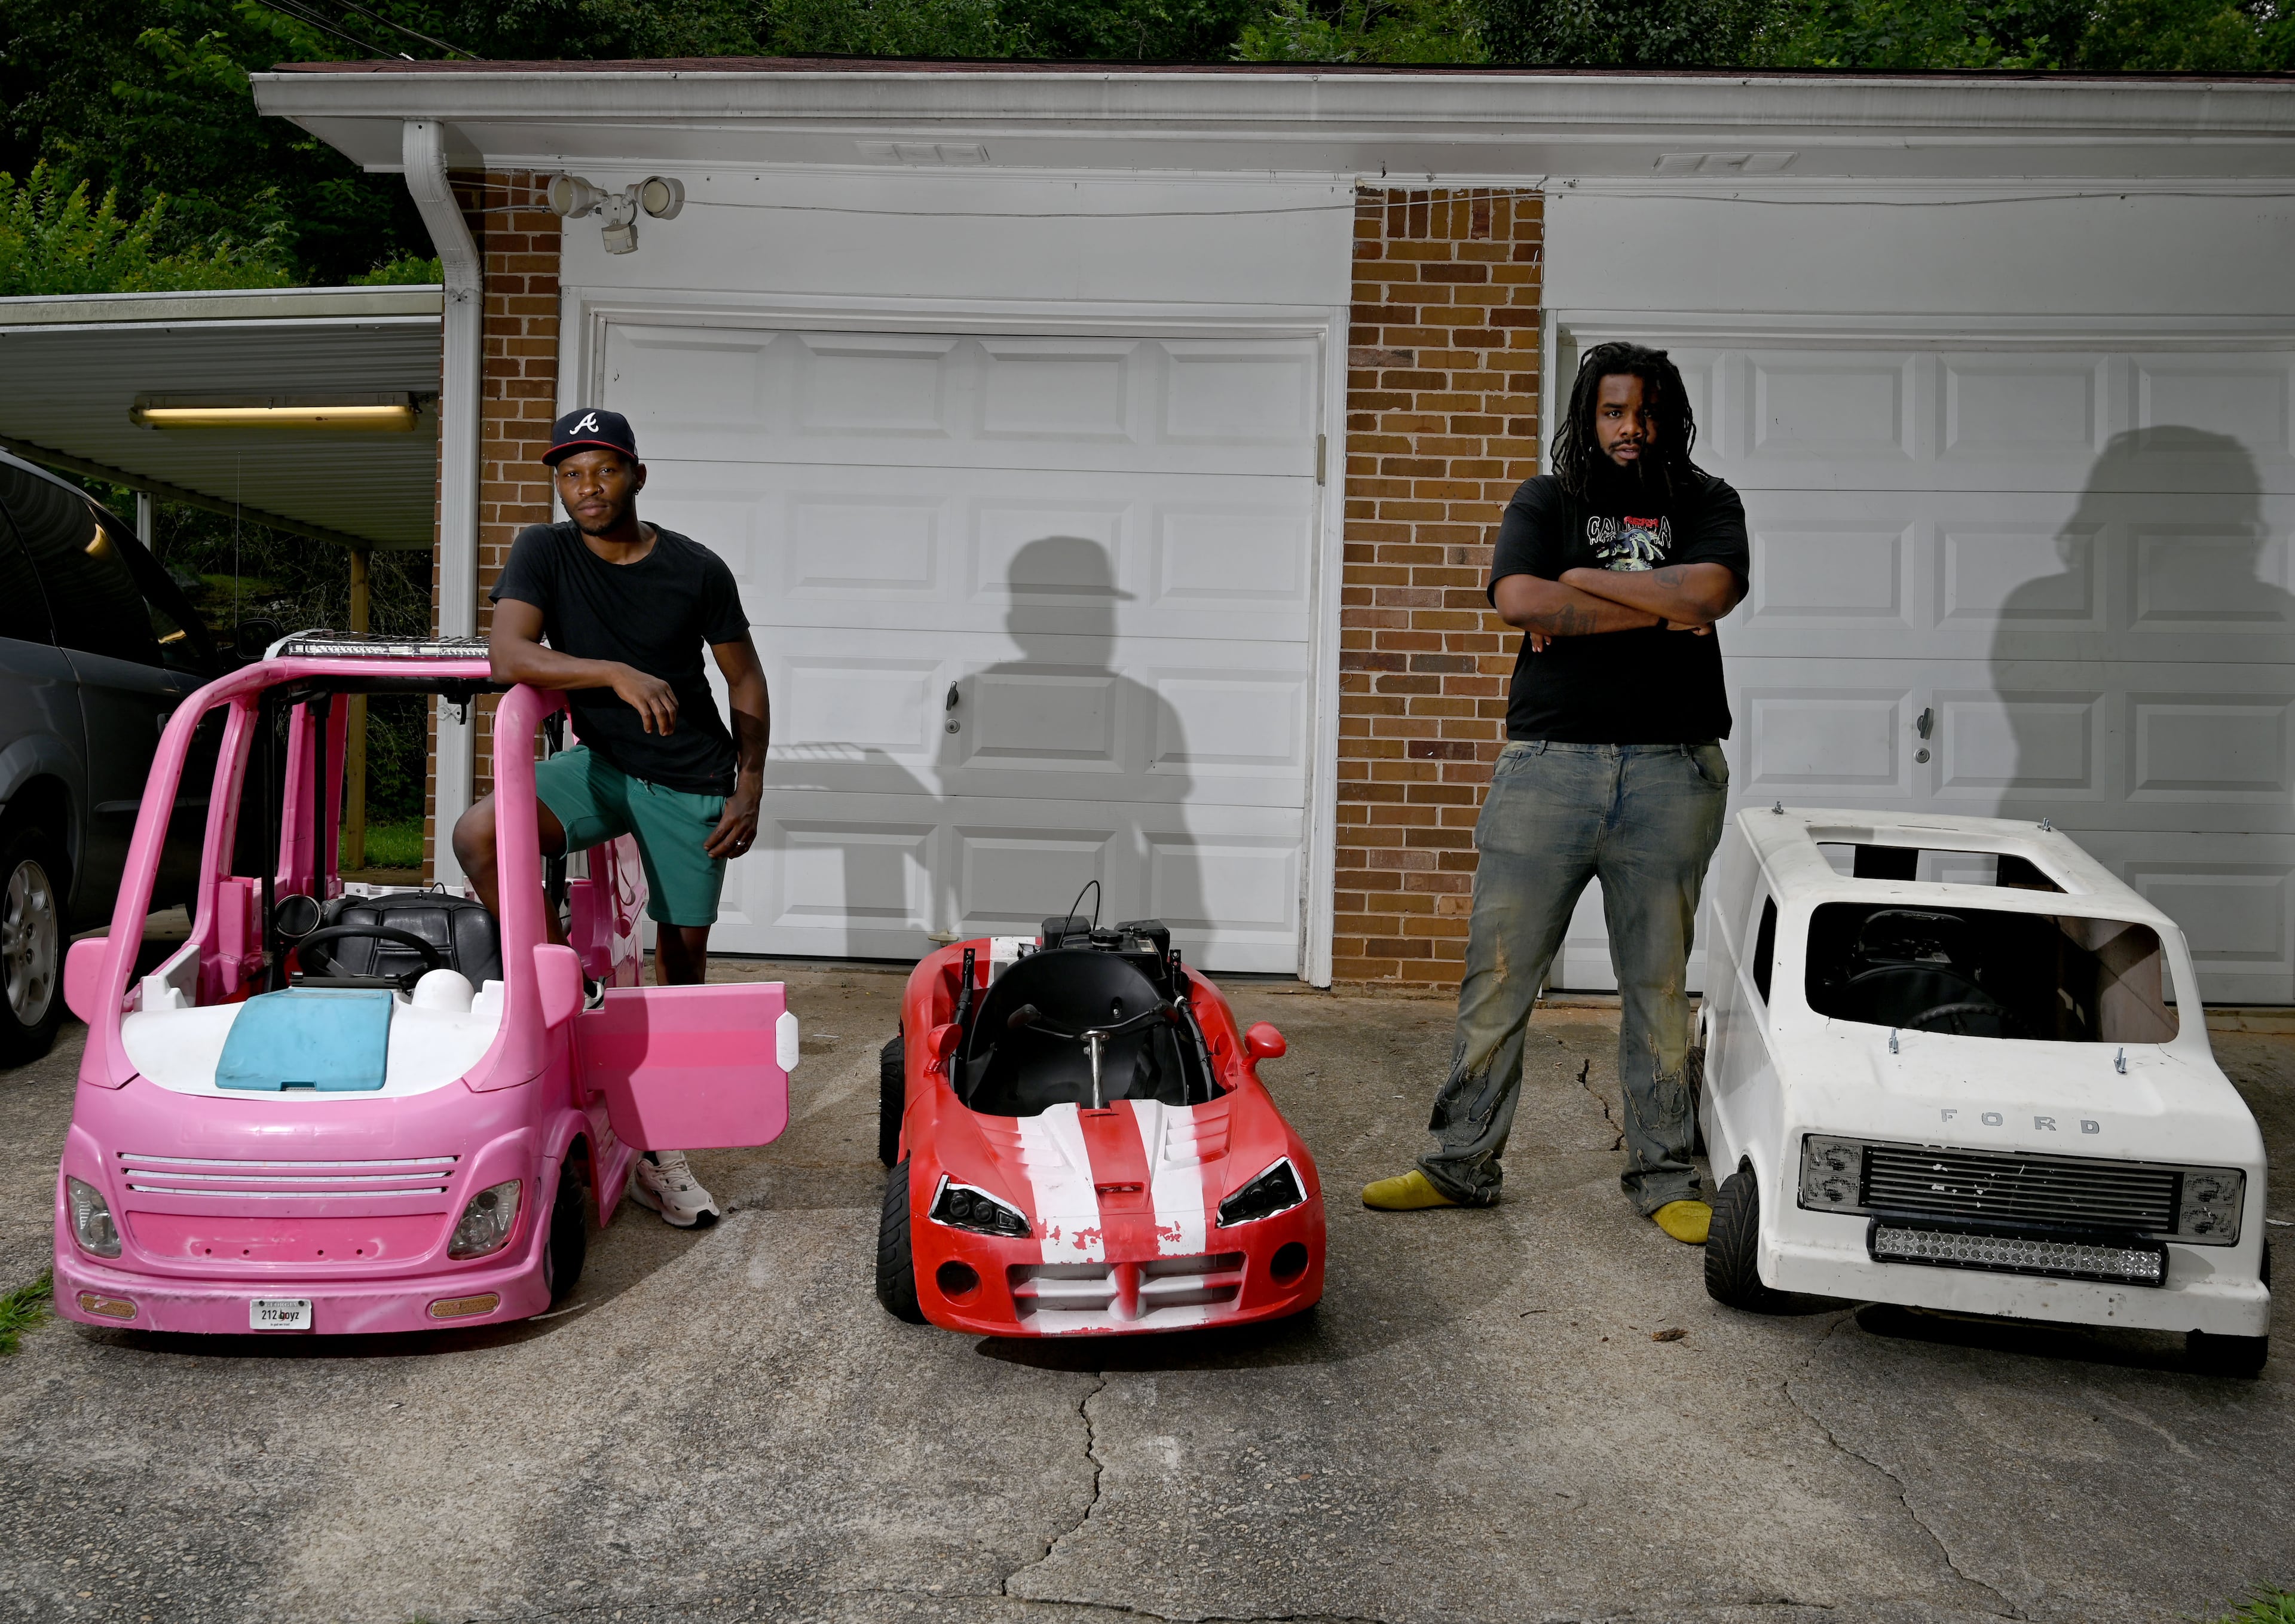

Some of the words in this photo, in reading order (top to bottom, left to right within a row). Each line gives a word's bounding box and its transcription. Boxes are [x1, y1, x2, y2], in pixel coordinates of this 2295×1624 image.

[569, 412, 599, 435] A
[1941, 1109, 2100, 1134] FORD
[262, 1310, 277, 1320] 212
[280, 1309, 299, 1322] boyz
